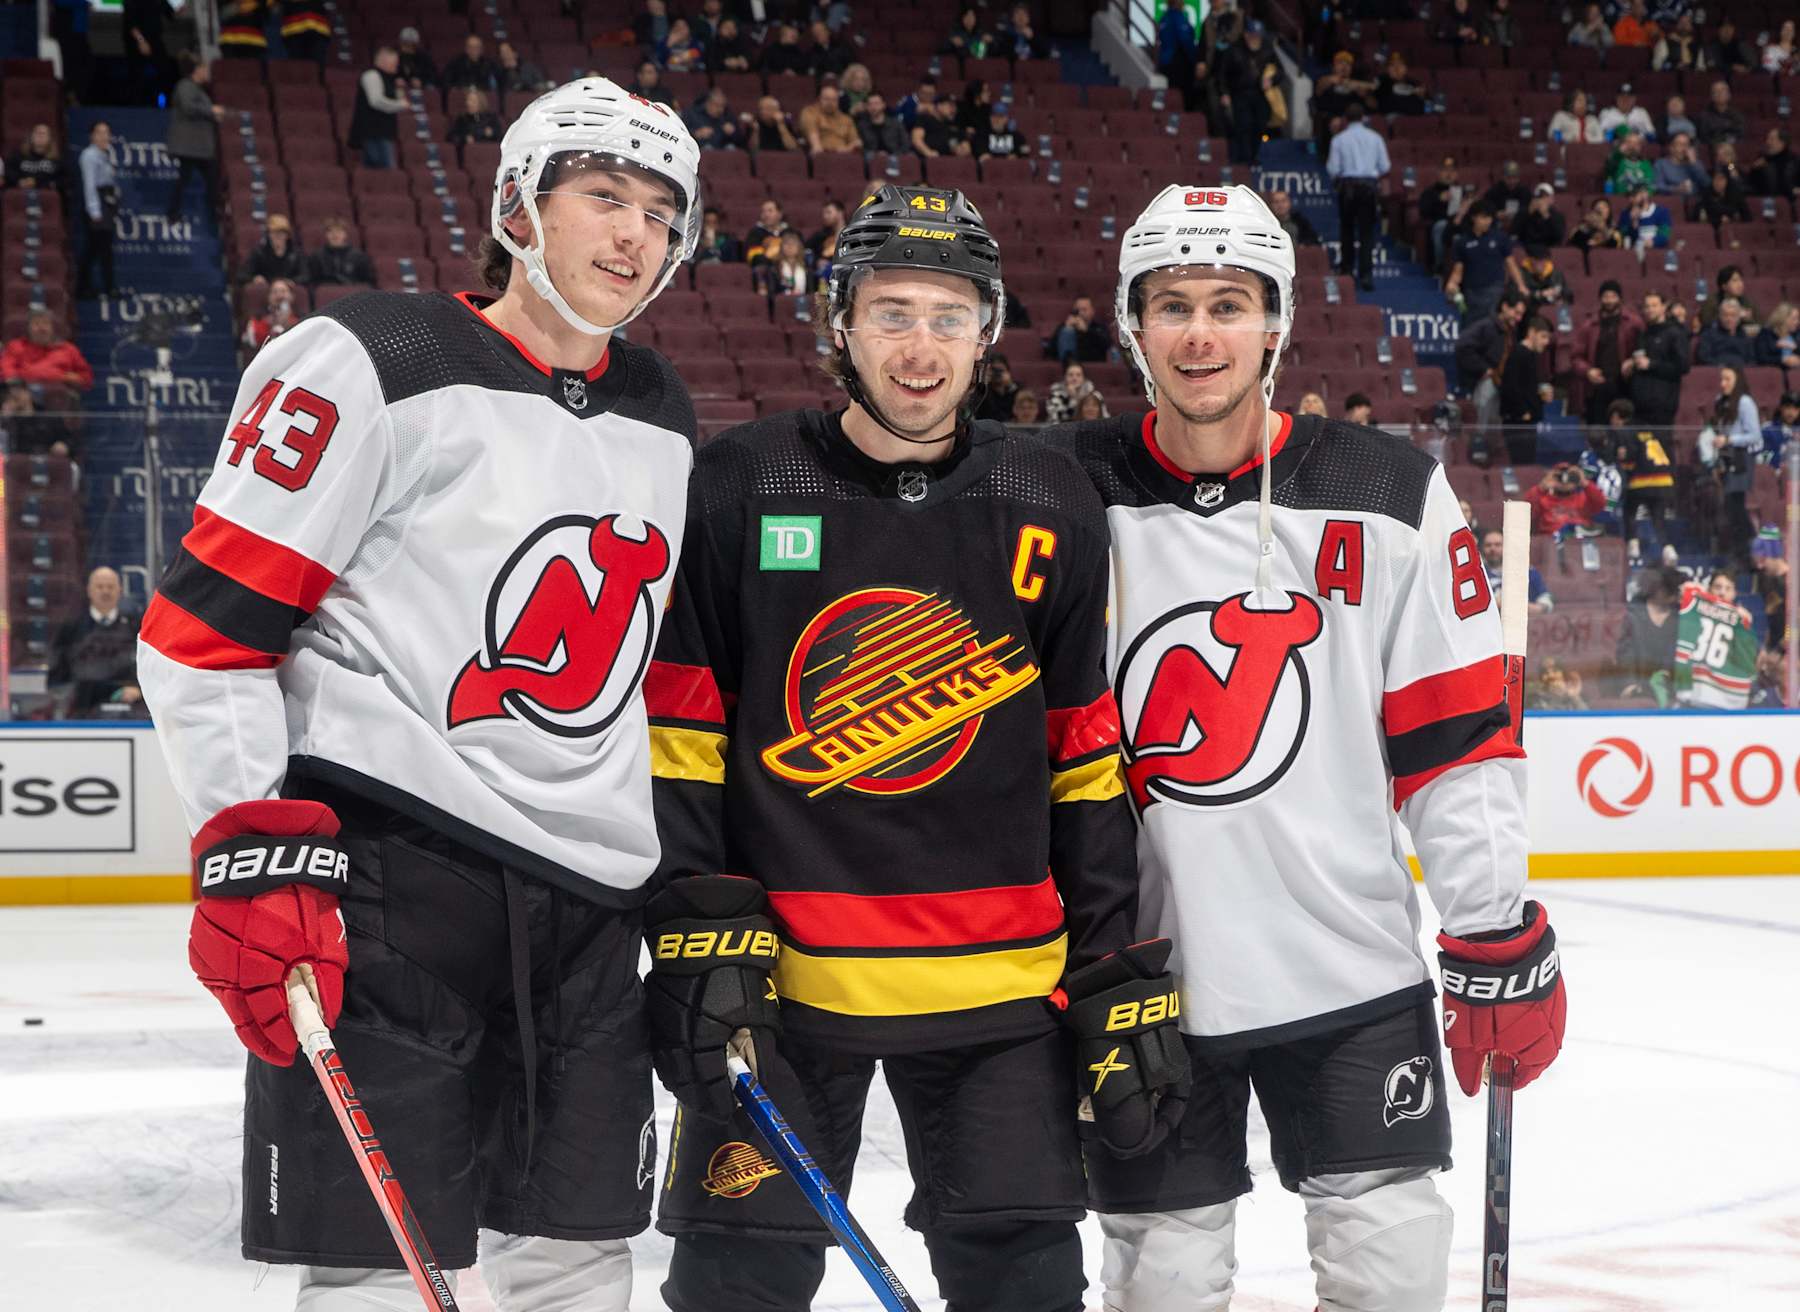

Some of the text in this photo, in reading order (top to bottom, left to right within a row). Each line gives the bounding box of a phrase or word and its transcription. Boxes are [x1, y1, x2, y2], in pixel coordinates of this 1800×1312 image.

[910, 195, 947, 213] 43
[1184, 191, 1229, 206] 86
[898, 227, 958, 241] BAUER
[1176, 227, 1232, 237] BAUER
[227, 378, 341, 493] 43
[767, 526, 815, 560] TD
[1010, 524, 1057, 602] C
[1315, 519, 1364, 606] A
[1681, 745, 1800, 807] RO
[201, 845, 350, 888] BAUER
[880, 1265, 910, 1299] HUGHES
